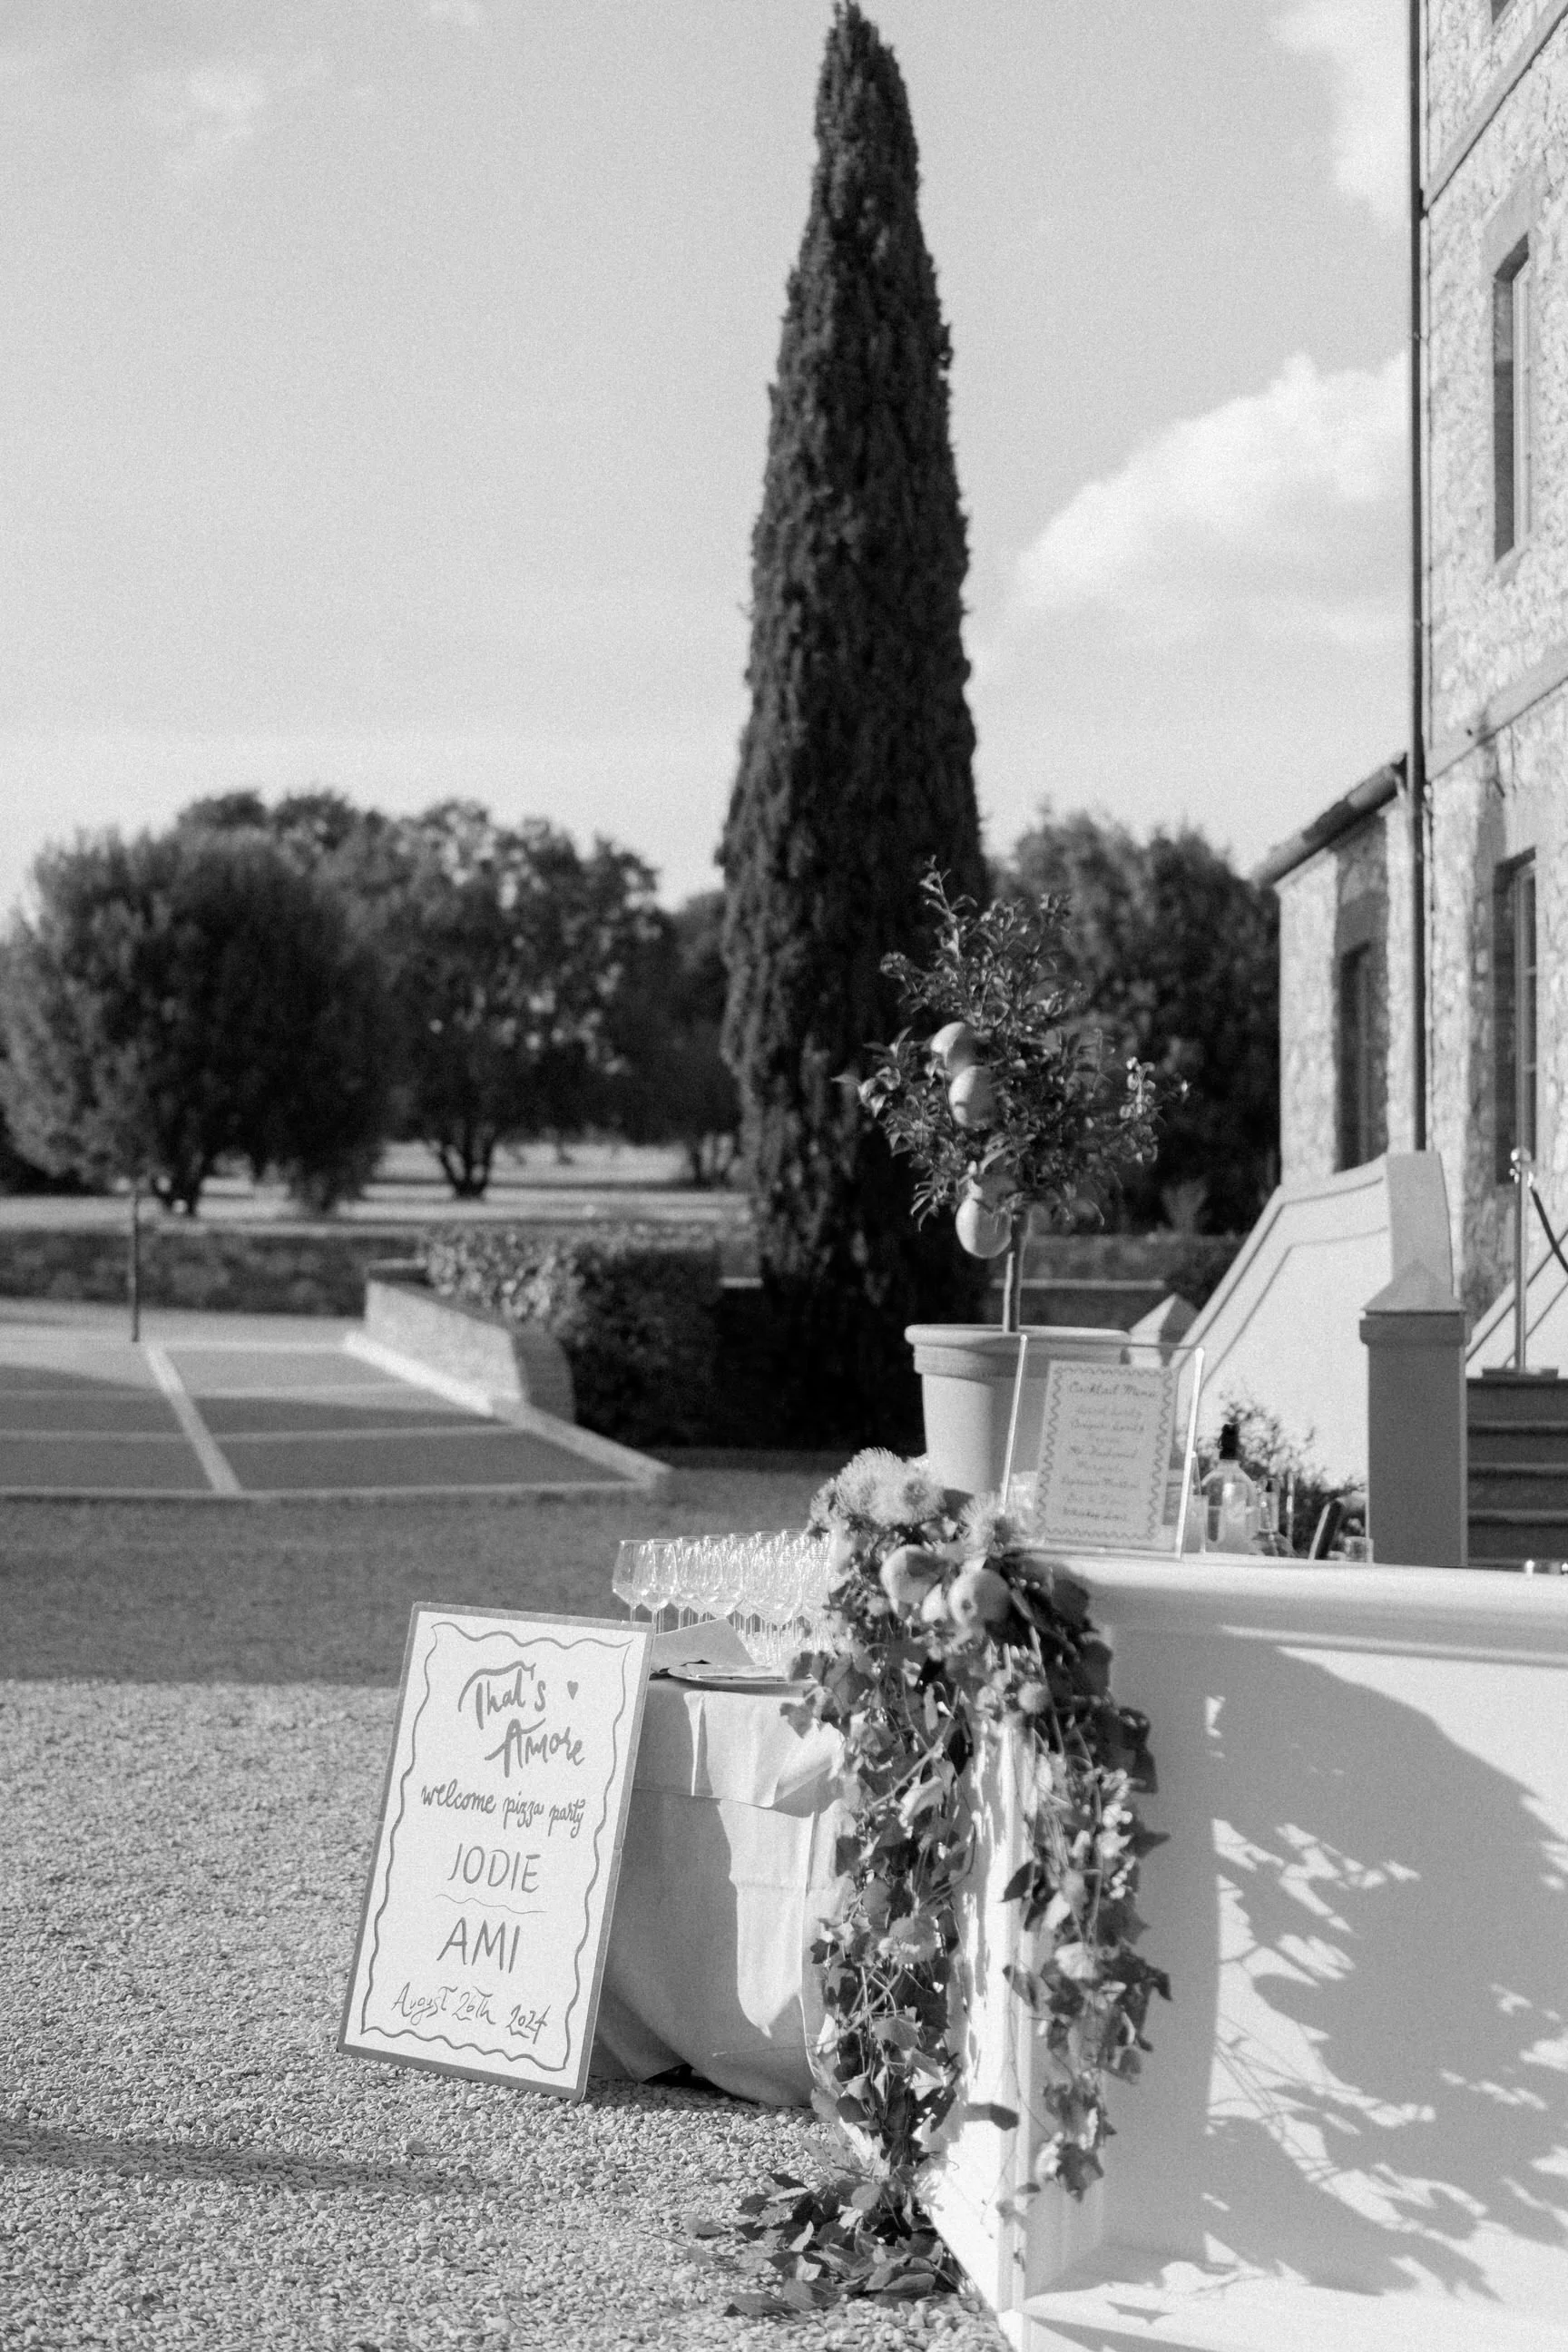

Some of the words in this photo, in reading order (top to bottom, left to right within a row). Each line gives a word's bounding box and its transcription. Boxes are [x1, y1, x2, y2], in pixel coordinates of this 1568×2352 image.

[457, 1661, 546, 1730] That's
[485, 1718, 586, 1779] Amore
[421, 1779, 497, 1814] welcome
[502, 1790, 545, 1830] pizza
[548, 1798, 586, 1838] party
[447, 1843, 541, 1894] JODIE
[436, 1916, 521, 1974] AMI
[505, 2004, 552, 2045] 2024
